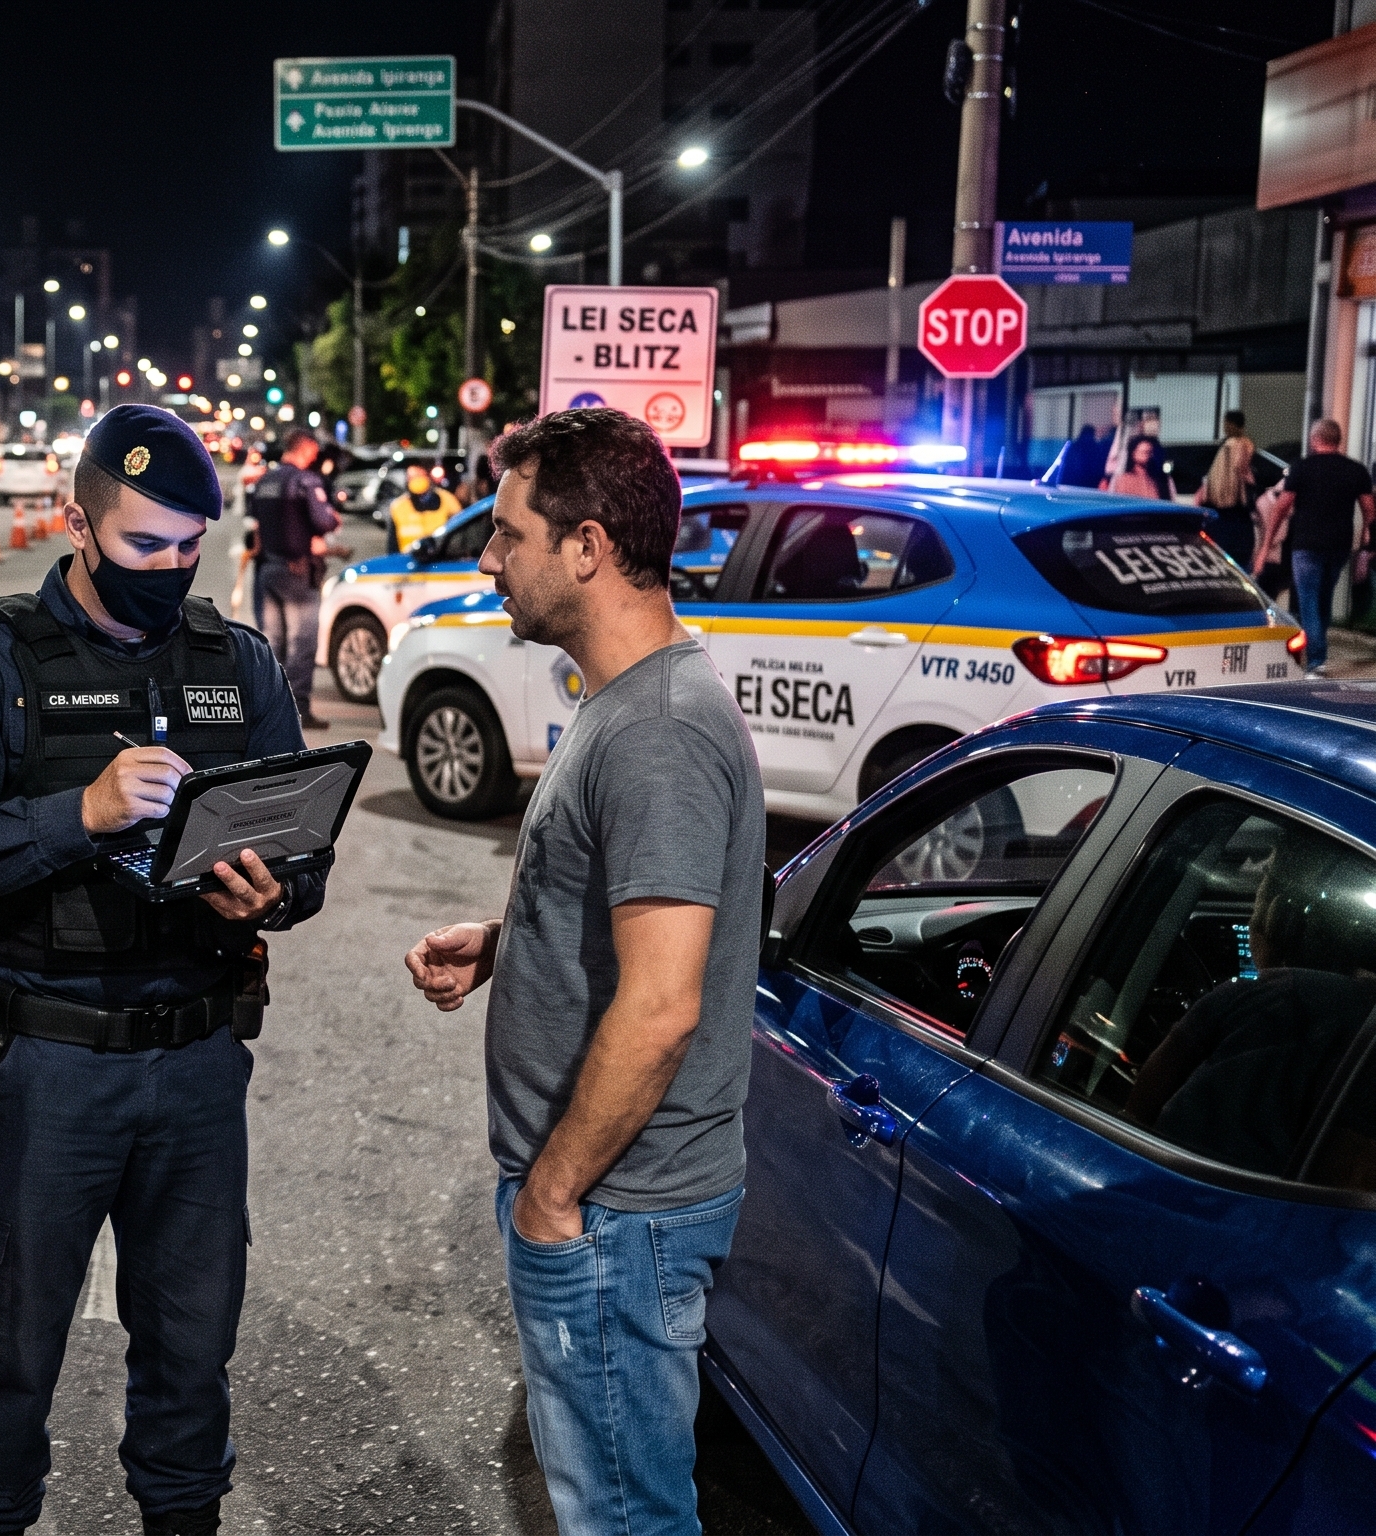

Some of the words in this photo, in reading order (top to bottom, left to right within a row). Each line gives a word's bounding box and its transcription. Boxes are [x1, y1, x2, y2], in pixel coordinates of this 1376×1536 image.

[1007, 227, 1084, 247] Avenida
[562, 305, 607, 332] LEI
[618, 306, 698, 334] SECA
[926, 308, 1019, 347] STOP
[594, 343, 681, 371] BLITZ
[1094, 546, 1166, 585] LEI
[921, 655, 960, 680] VTR
[965, 661, 1015, 685] 3450
[1222, 645, 1250, 674] FIAT
[1164, 669, 1196, 687] VTR
[48, 695, 69, 706] CB.
[72, 694, 120, 706] MENDES
[187, 688, 238, 705] POLÍCIA
[735, 673, 762, 716] EI
[771, 677, 855, 727] SECA
[191, 705, 240, 720] MILITAR
